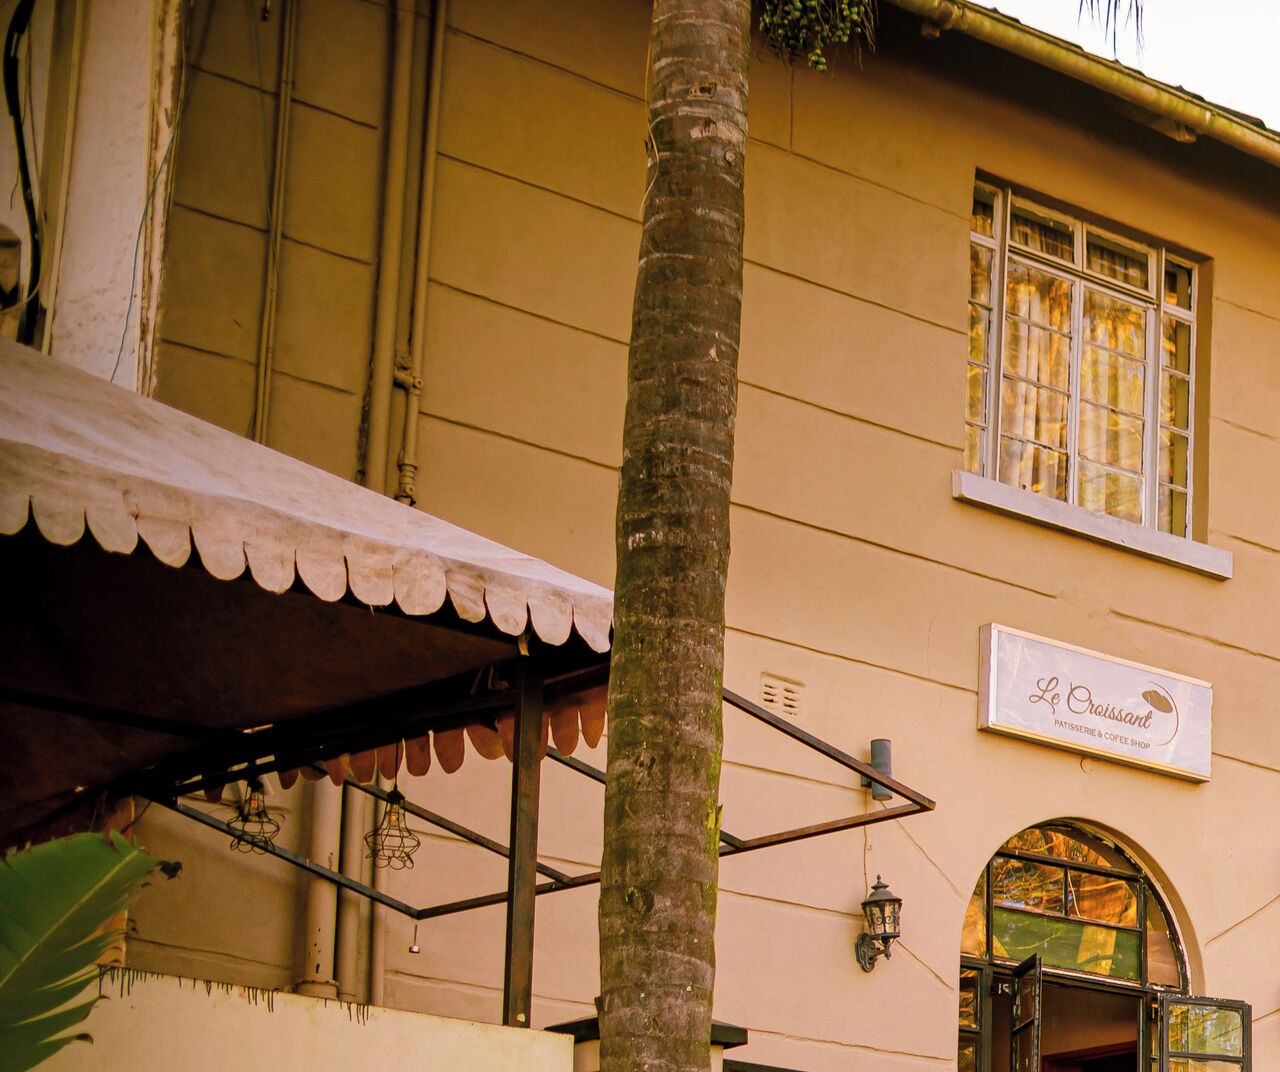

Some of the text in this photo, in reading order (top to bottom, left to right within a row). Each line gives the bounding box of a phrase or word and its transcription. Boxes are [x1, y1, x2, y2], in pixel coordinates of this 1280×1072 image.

[1028, 676, 1153, 729] Le Croissant
[1054, 719, 1097, 737] PATISSERIE
[1104, 731, 1130, 746] COFEE
[1130, 738, 1151, 750] SHOP
